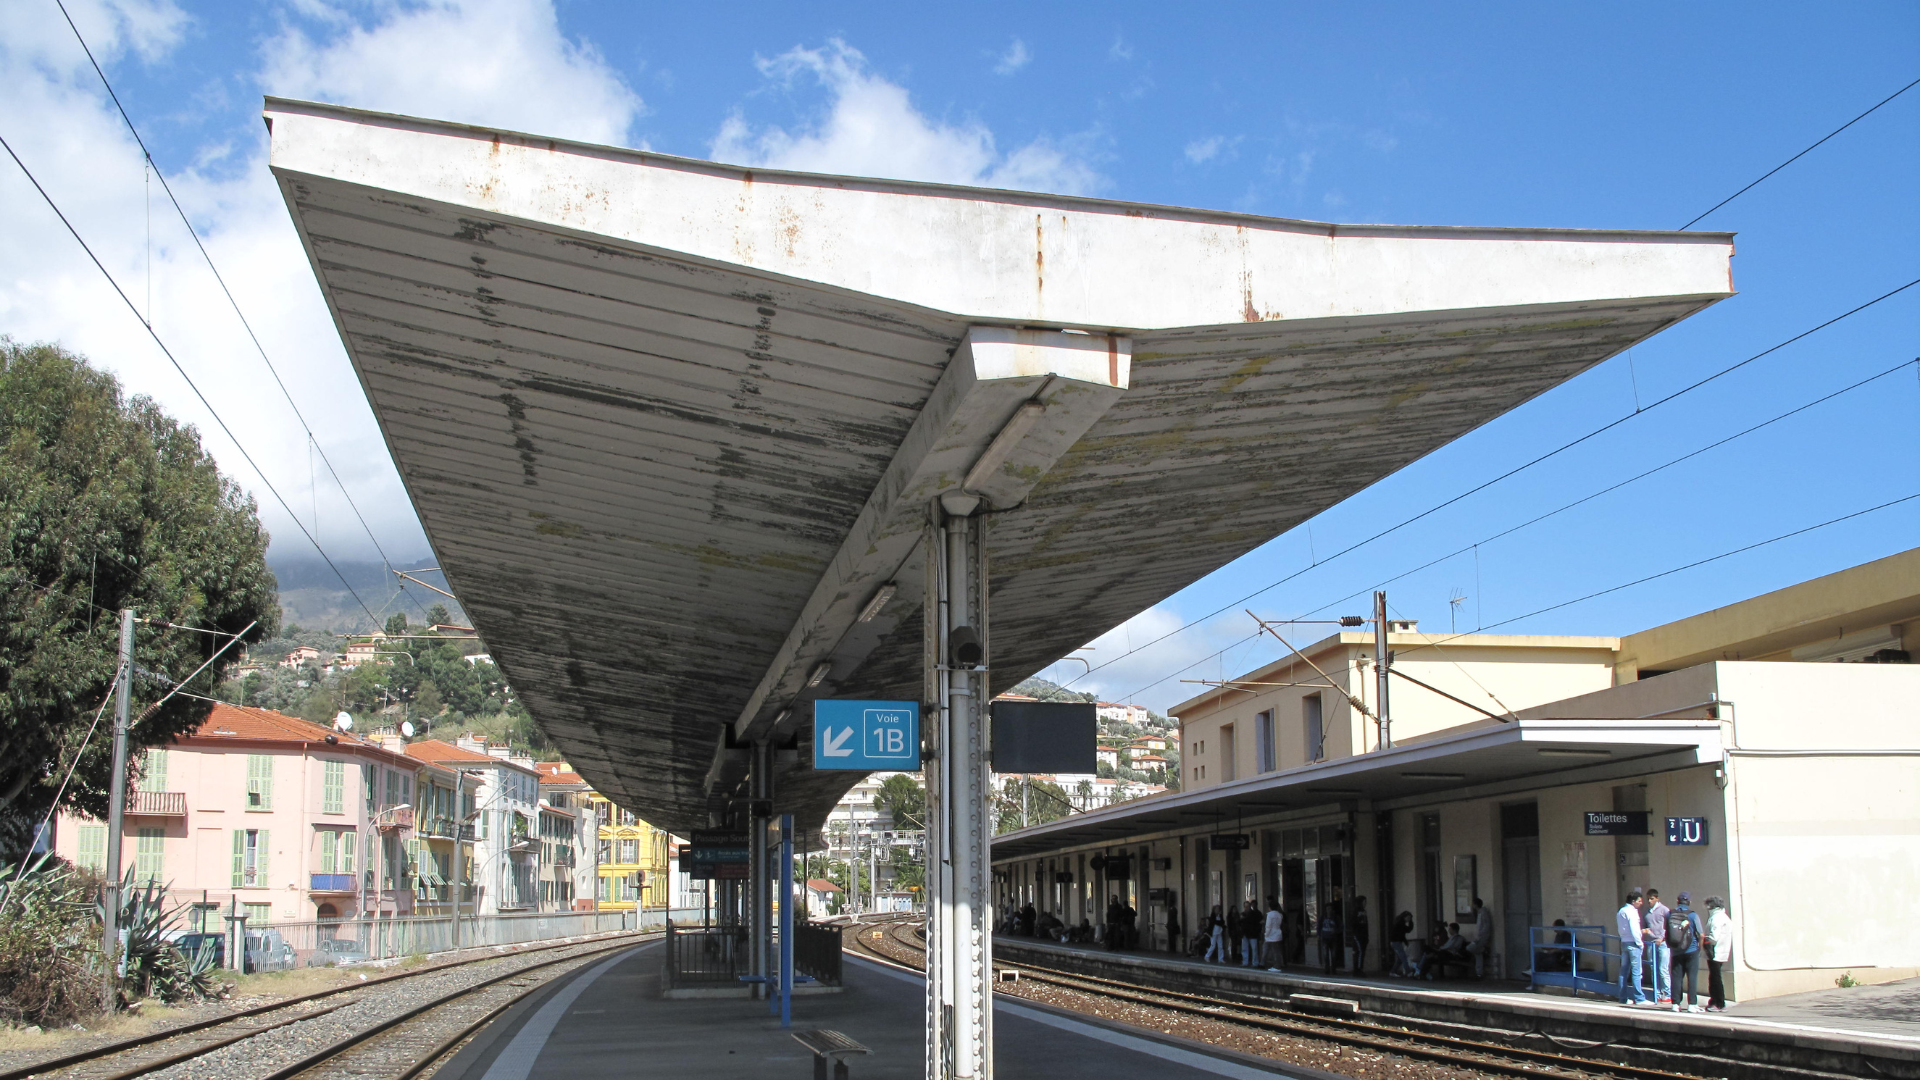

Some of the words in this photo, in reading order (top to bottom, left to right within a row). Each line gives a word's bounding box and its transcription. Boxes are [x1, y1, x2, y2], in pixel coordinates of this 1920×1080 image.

[876, 713, 899, 723] Voie
[873, 727, 904, 753] 1B
[1587, 813, 1628, 823] Toilettes
[1684, 822, 1701, 843] U
[696, 834, 728, 843] Passage
